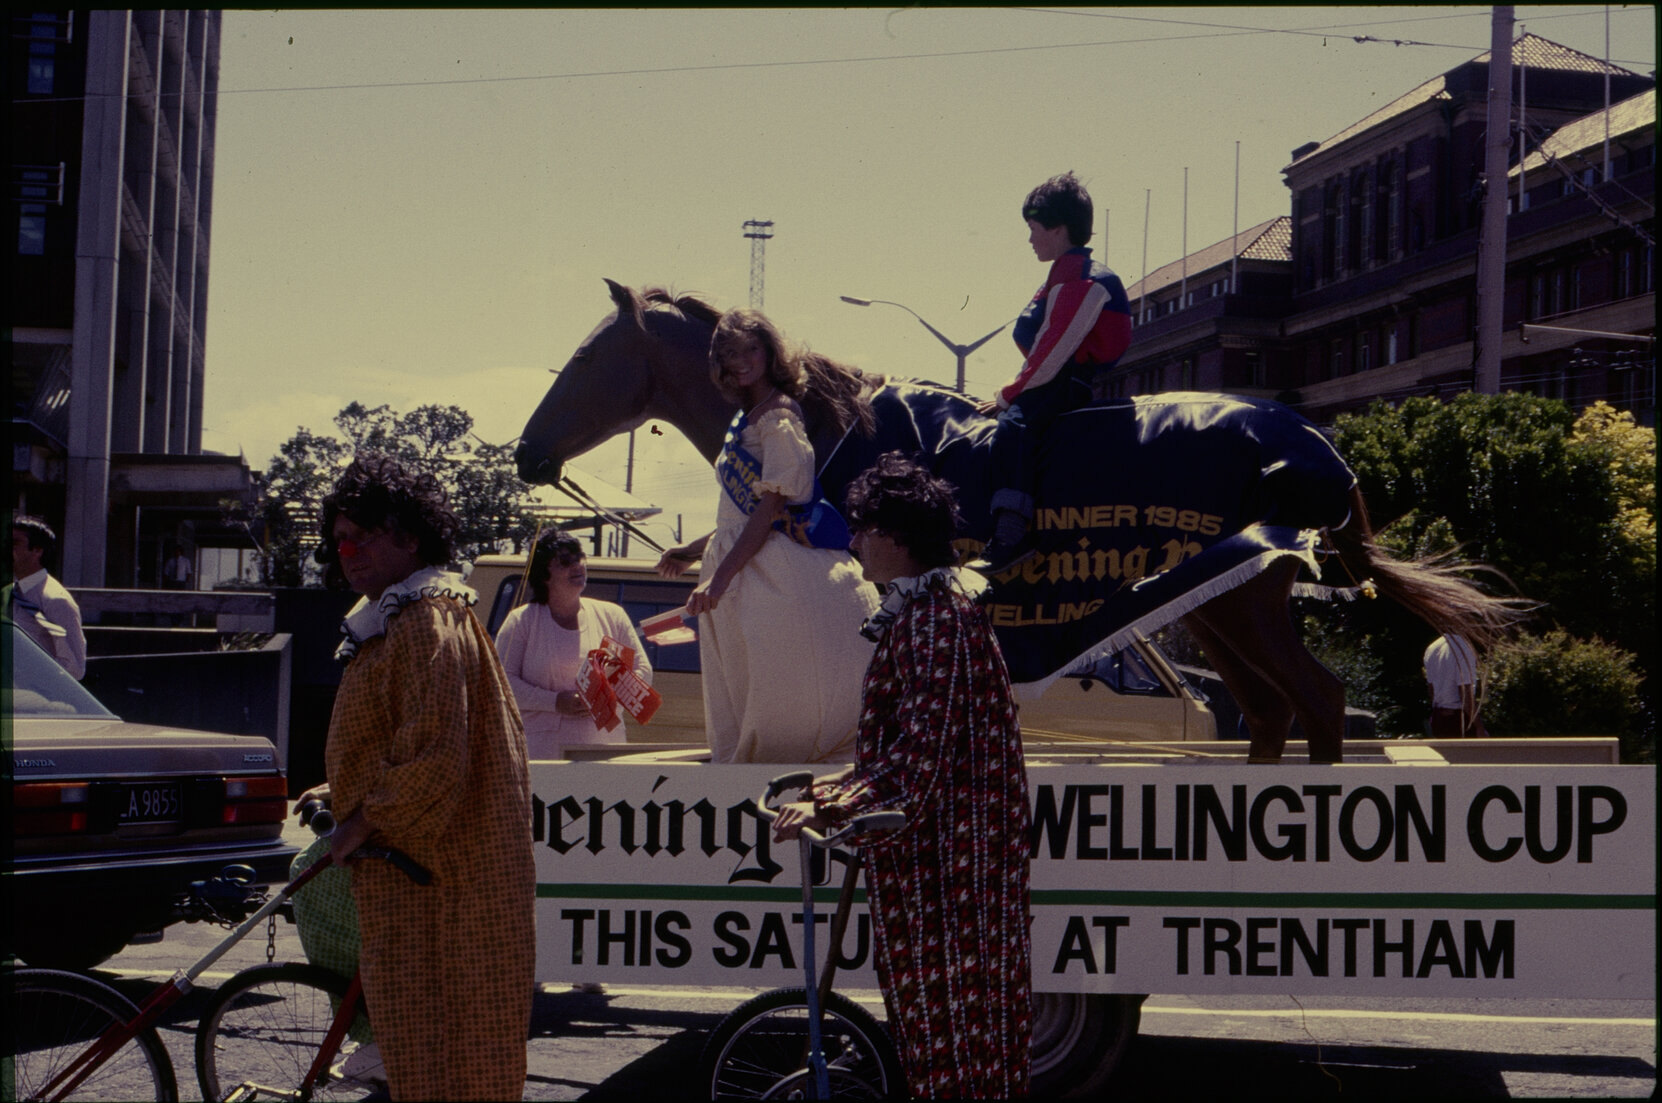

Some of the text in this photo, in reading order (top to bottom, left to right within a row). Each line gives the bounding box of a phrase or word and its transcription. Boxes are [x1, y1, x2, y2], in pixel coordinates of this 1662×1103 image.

[1028, 504, 1225, 537] INNER 1985
[616, 670, 651, 702] JUST
[14, 759, 56, 769] HONDA
[120, 787, 178, 819] A9855
[1030, 784, 1447, 863] WELLINGTON
[1467, 784, 1628, 864] CUP
[561, 909, 692, 968] THIS
[1052, 916, 1130, 975] AT
[1163, 916, 1516, 979] TRENTHAM
